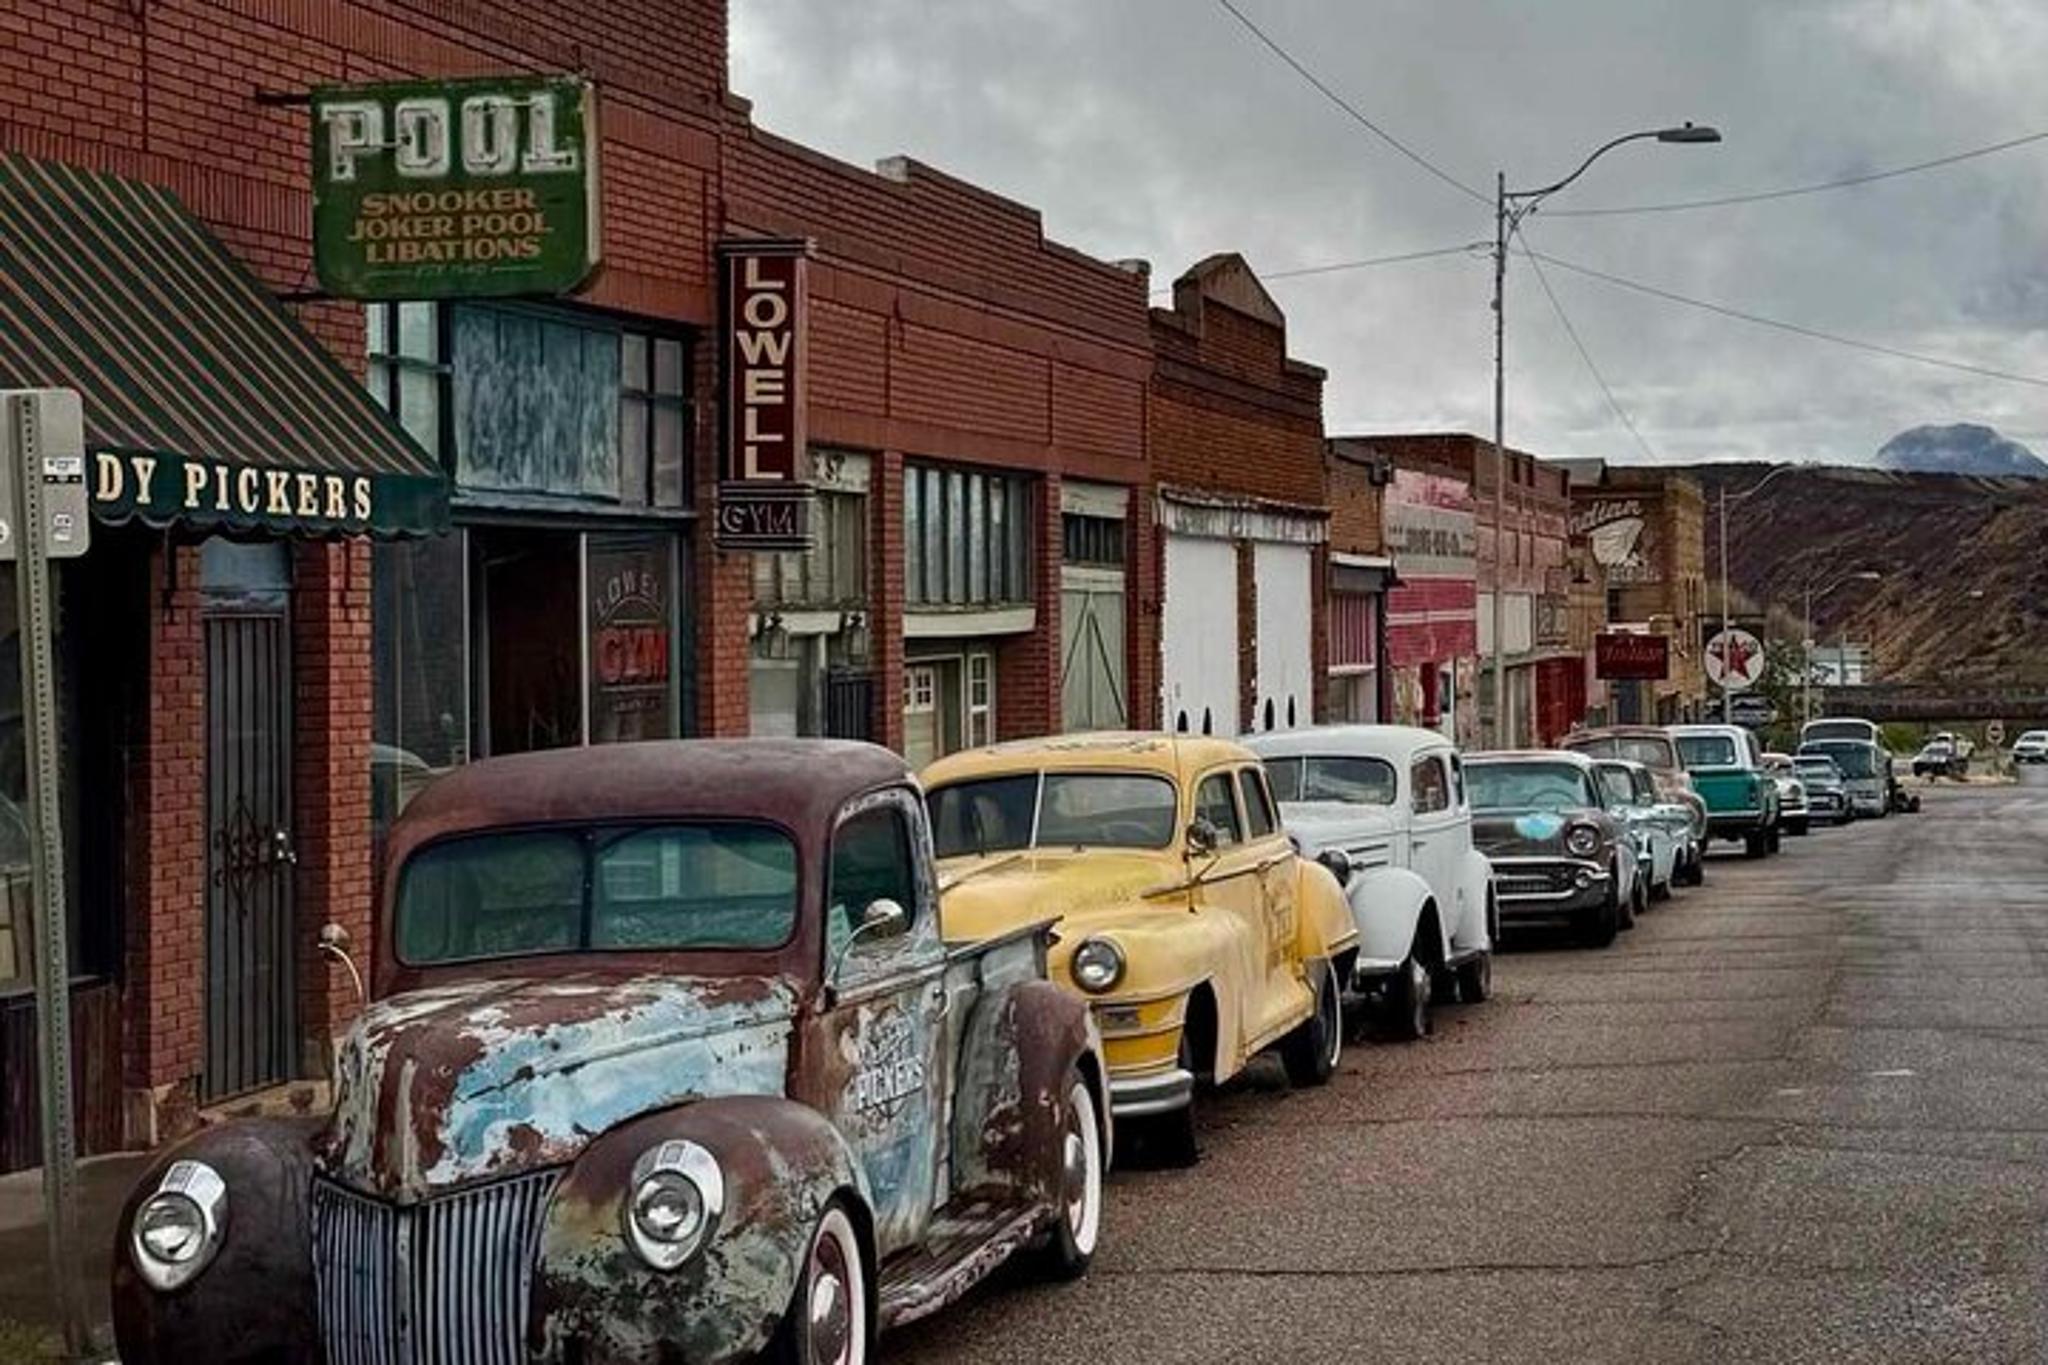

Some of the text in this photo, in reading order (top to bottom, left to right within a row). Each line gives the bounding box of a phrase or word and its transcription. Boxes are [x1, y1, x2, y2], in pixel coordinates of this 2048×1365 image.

[321, 91, 579, 181] POOL
[361, 188, 537, 215] SNOOKER
[347, 212, 554, 240] JOKER POOL
[365, 236, 542, 263] LIBATIONS
[736, 257, 792, 480] LOWELL
[184, 463, 372, 520] PICKERS
[721, 504, 795, 533] GYM
[600, 627, 668, 683] GYM
